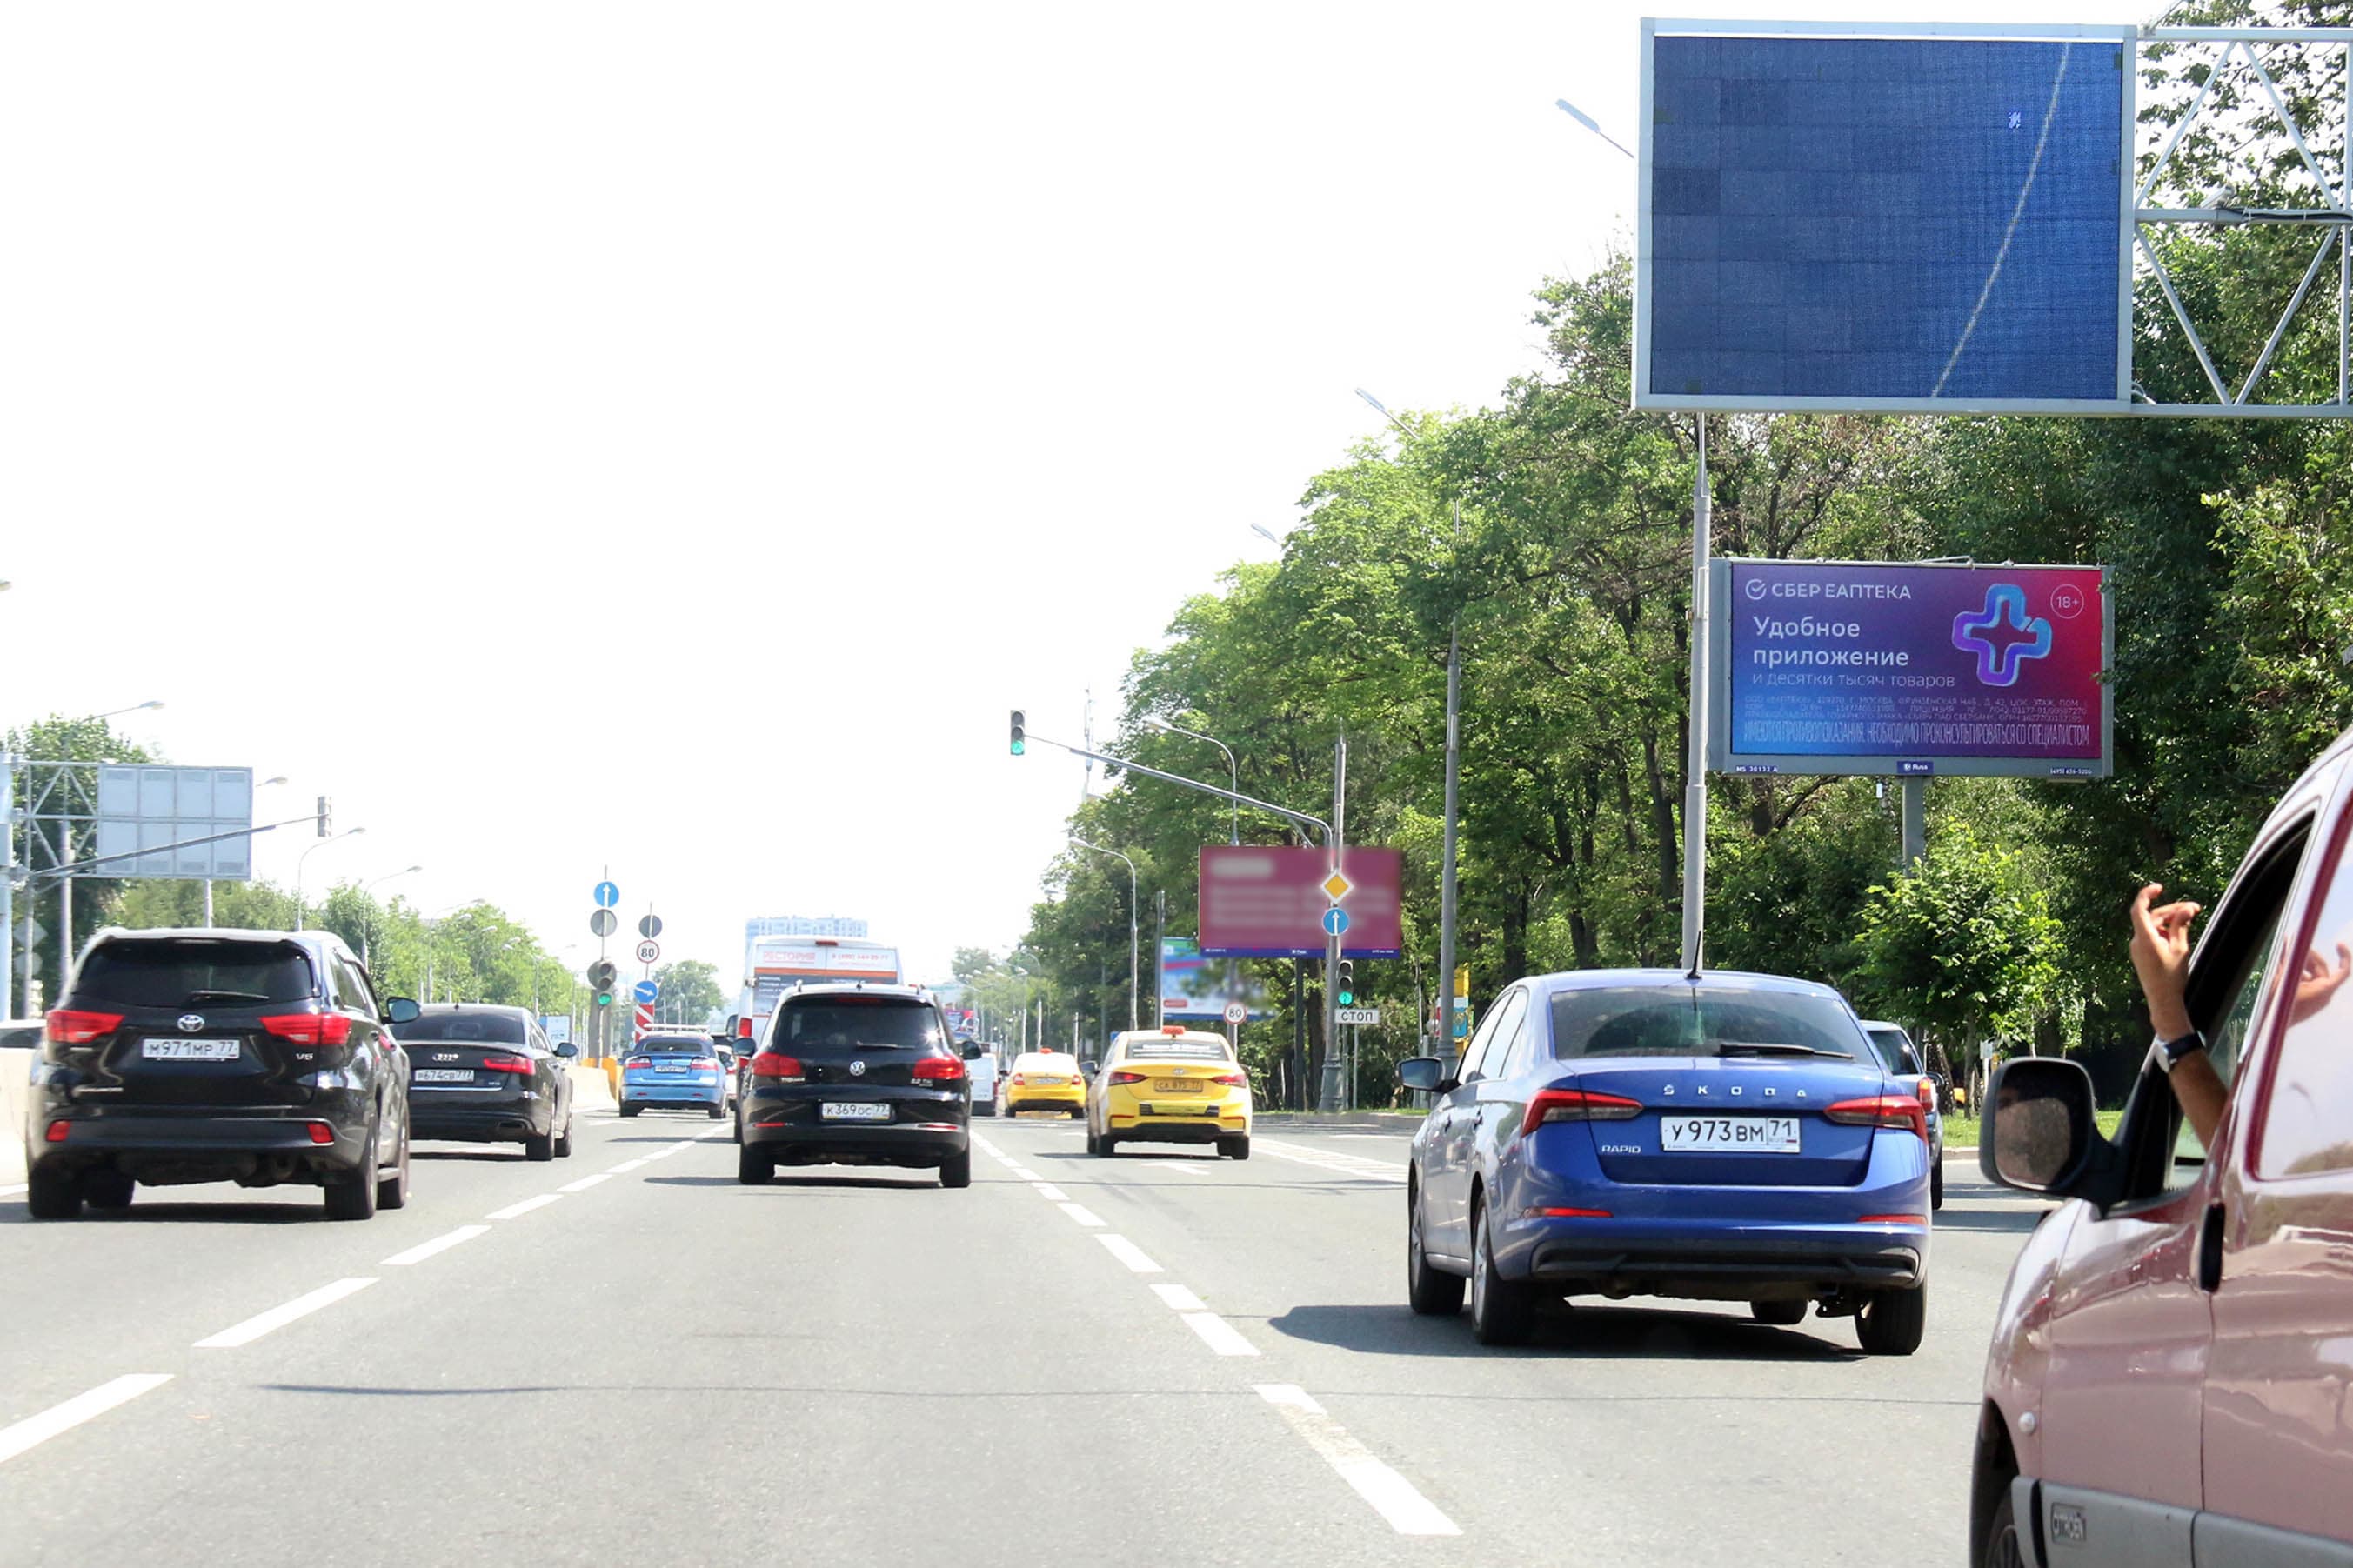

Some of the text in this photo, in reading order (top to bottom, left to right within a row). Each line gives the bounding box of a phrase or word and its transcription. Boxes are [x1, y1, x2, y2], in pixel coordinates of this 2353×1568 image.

[1771, 583, 1912, 599] СБЕР ЕАПТЕКА
[2056, 596, 2079, 608] 18+
[1753, 616, 1861, 639] Удобное
[1753, 650, 1909, 669] приложение
[1753, 673, 1955, 690] и десятки тысяч товаров
[641, 948, 654, 958] 80
[1229, 1009, 1242, 1018] 80
[1341, 1011, 1373, 1022] СТОП
[1601, 1144, 1641, 1154] RAPID
